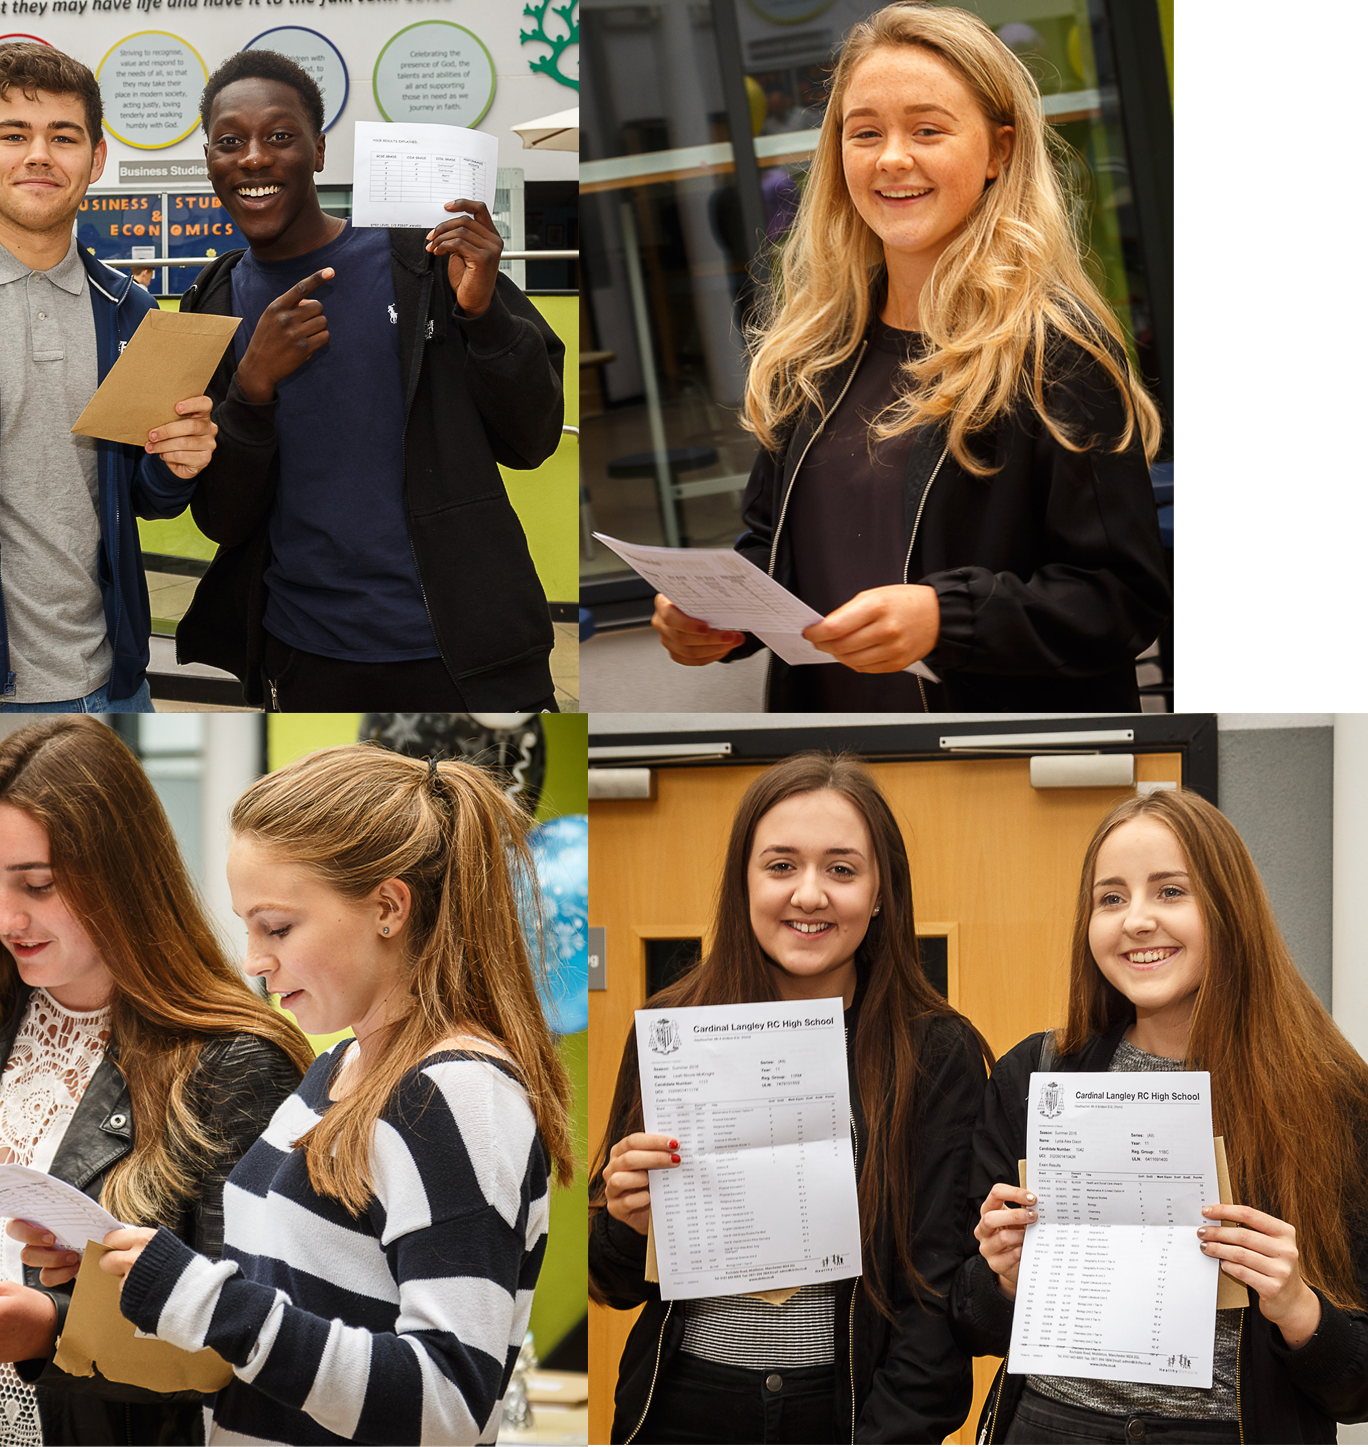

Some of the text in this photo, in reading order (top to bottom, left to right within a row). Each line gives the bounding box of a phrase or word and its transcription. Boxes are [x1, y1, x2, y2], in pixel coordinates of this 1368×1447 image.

[12, 0, 48, 16] they
[52, 1, 87, 14] may
[92, 0, 132, 11] have
[120, 49, 143, 58] Striving
[152, 49, 183, 57] recognise,
[409, 50, 448, 58] Celebrating
[151, 59, 176, 67] respond
[400, 62, 431, 70] presence
[432, 60, 440, 68] of
[441, 60, 457, 68] God,
[397, 72, 420, 80] talents
[436, 71, 462, 79] abilities
[463, 70, 471, 78] of
[429, 82, 465, 90] supporting
[122, 101, 181, 110] acting justly, loving
[409, 105, 435, 113] journey
[159, 111, 183, 119] walking
[126, 122, 148, 130] humbly
[164, 121, 179, 129] God.
[120, 165, 209, 177] Business Studies
[79, 196, 223, 212] USINESS STUD
[151, 210, 162, 223] &
[110, 223, 234, 236] ECONOMICS
[693, 1017, 834, 1033] Cardinal Langley RC High School
[1075, 1091, 1200, 1101] Cardinal Langley RC High School
